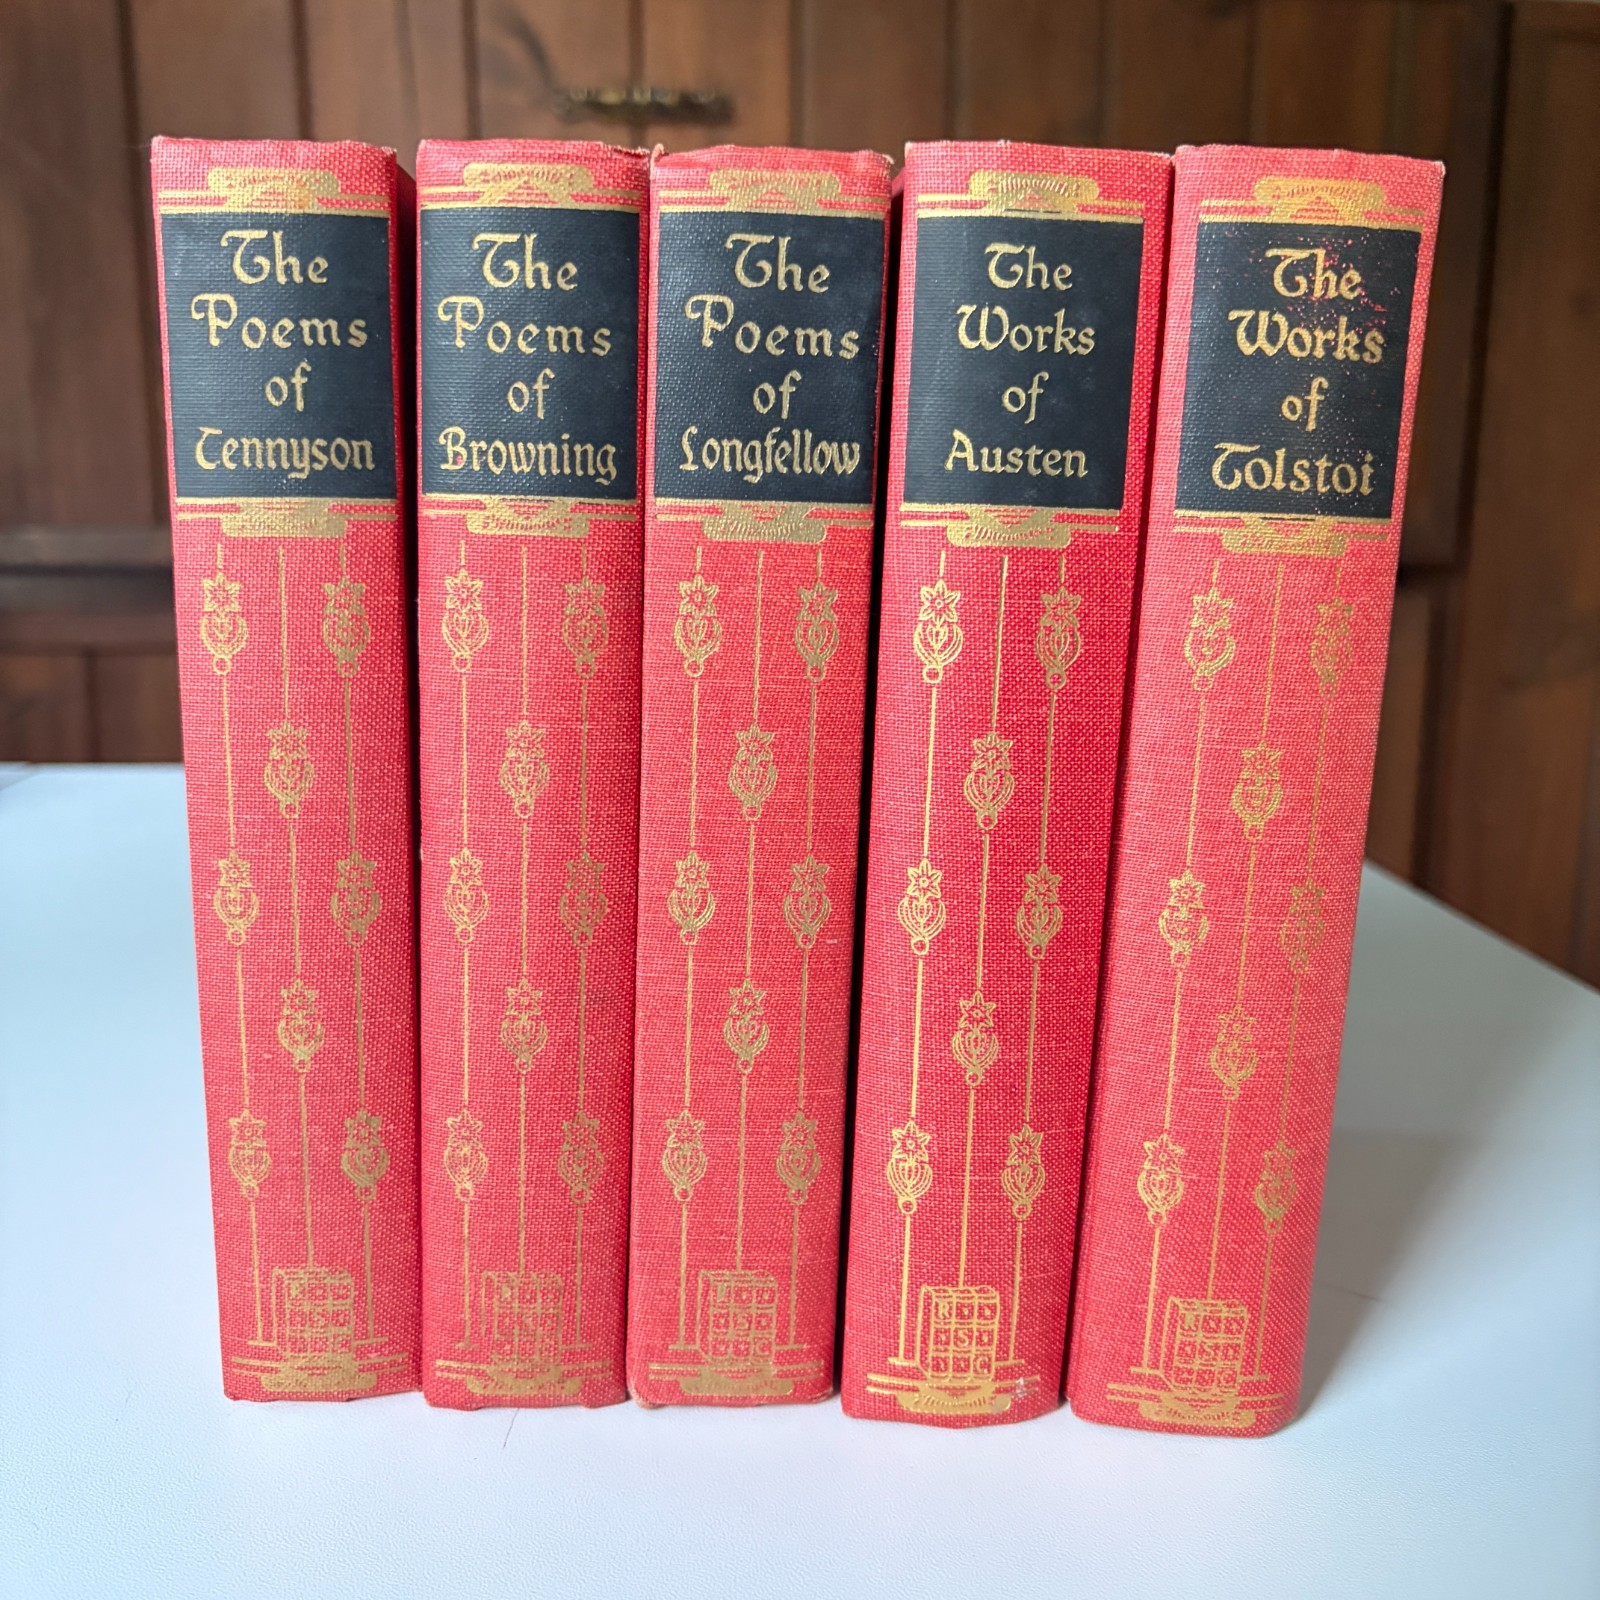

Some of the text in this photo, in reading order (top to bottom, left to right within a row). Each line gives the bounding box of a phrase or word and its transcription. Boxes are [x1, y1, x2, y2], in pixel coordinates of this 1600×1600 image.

[220, 228, 329, 286] The
[471, 231, 578, 291] The
[724, 233, 830, 294] The
[984, 242, 1073, 291] The
[1265, 246, 1362, 301] The
[190, 295, 368, 353] Poems
[436, 295, 612, 357] Poems
[683, 293, 860, 360] Poems
[956, 302, 1095, 356] Works
[1227, 308, 1385, 364] Works
[264, 358, 311, 412] of
[506, 368, 556, 420] of
[752, 370, 802, 420] of
[1001, 372, 1050, 424] of
[1281, 376, 1329, 432] of
[193, 427, 375, 480] Tennyson
[438, 426, 618, 486] Browning
[679, 426, 861, 484] Longfellow
[944, 429, 1089, 478] Austen
[1211, 442, 1374, 496] Tolstoi
